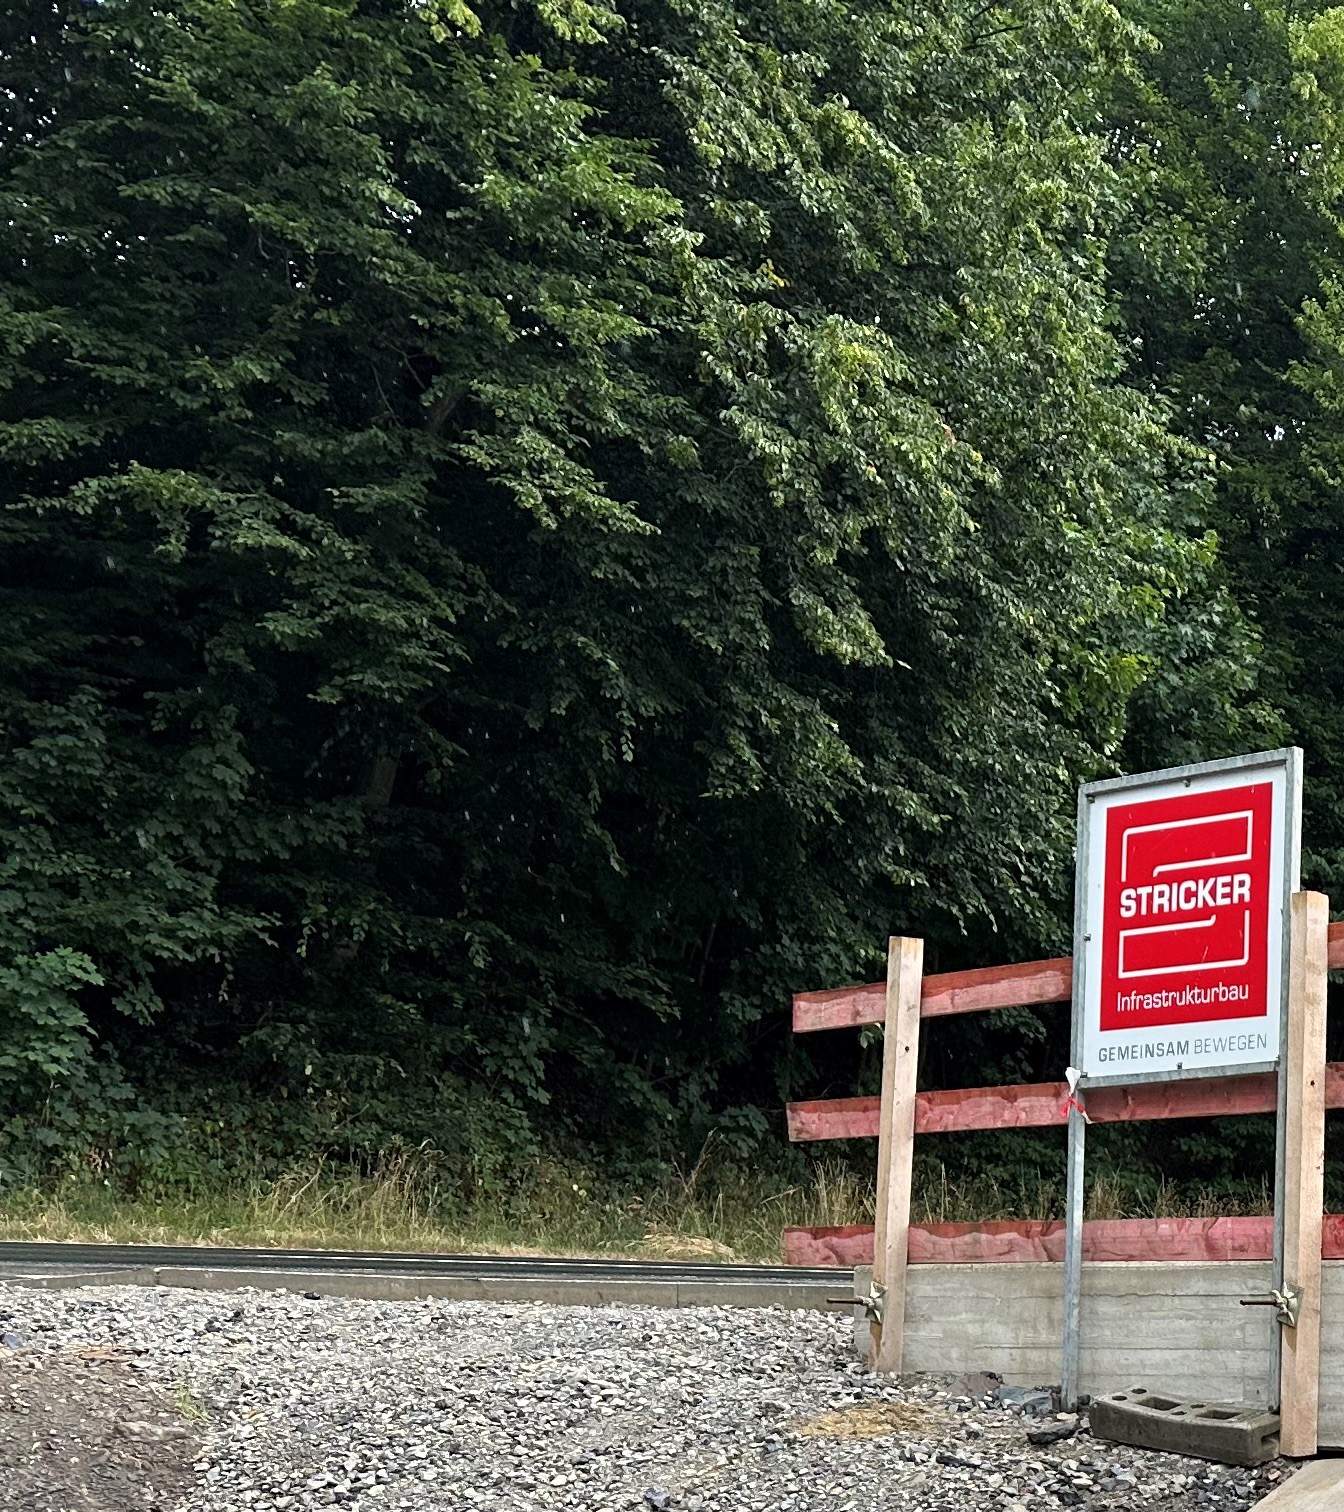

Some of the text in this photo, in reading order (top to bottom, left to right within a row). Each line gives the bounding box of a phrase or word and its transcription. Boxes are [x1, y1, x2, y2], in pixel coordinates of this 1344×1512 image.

[1120, 872, 1252, 918] STRICKER
[1116, 981, 1250, 1013] Infrastrukturbau
[1098, 1033, 1268, 1063] GEMEINSAM BEWEGEN
